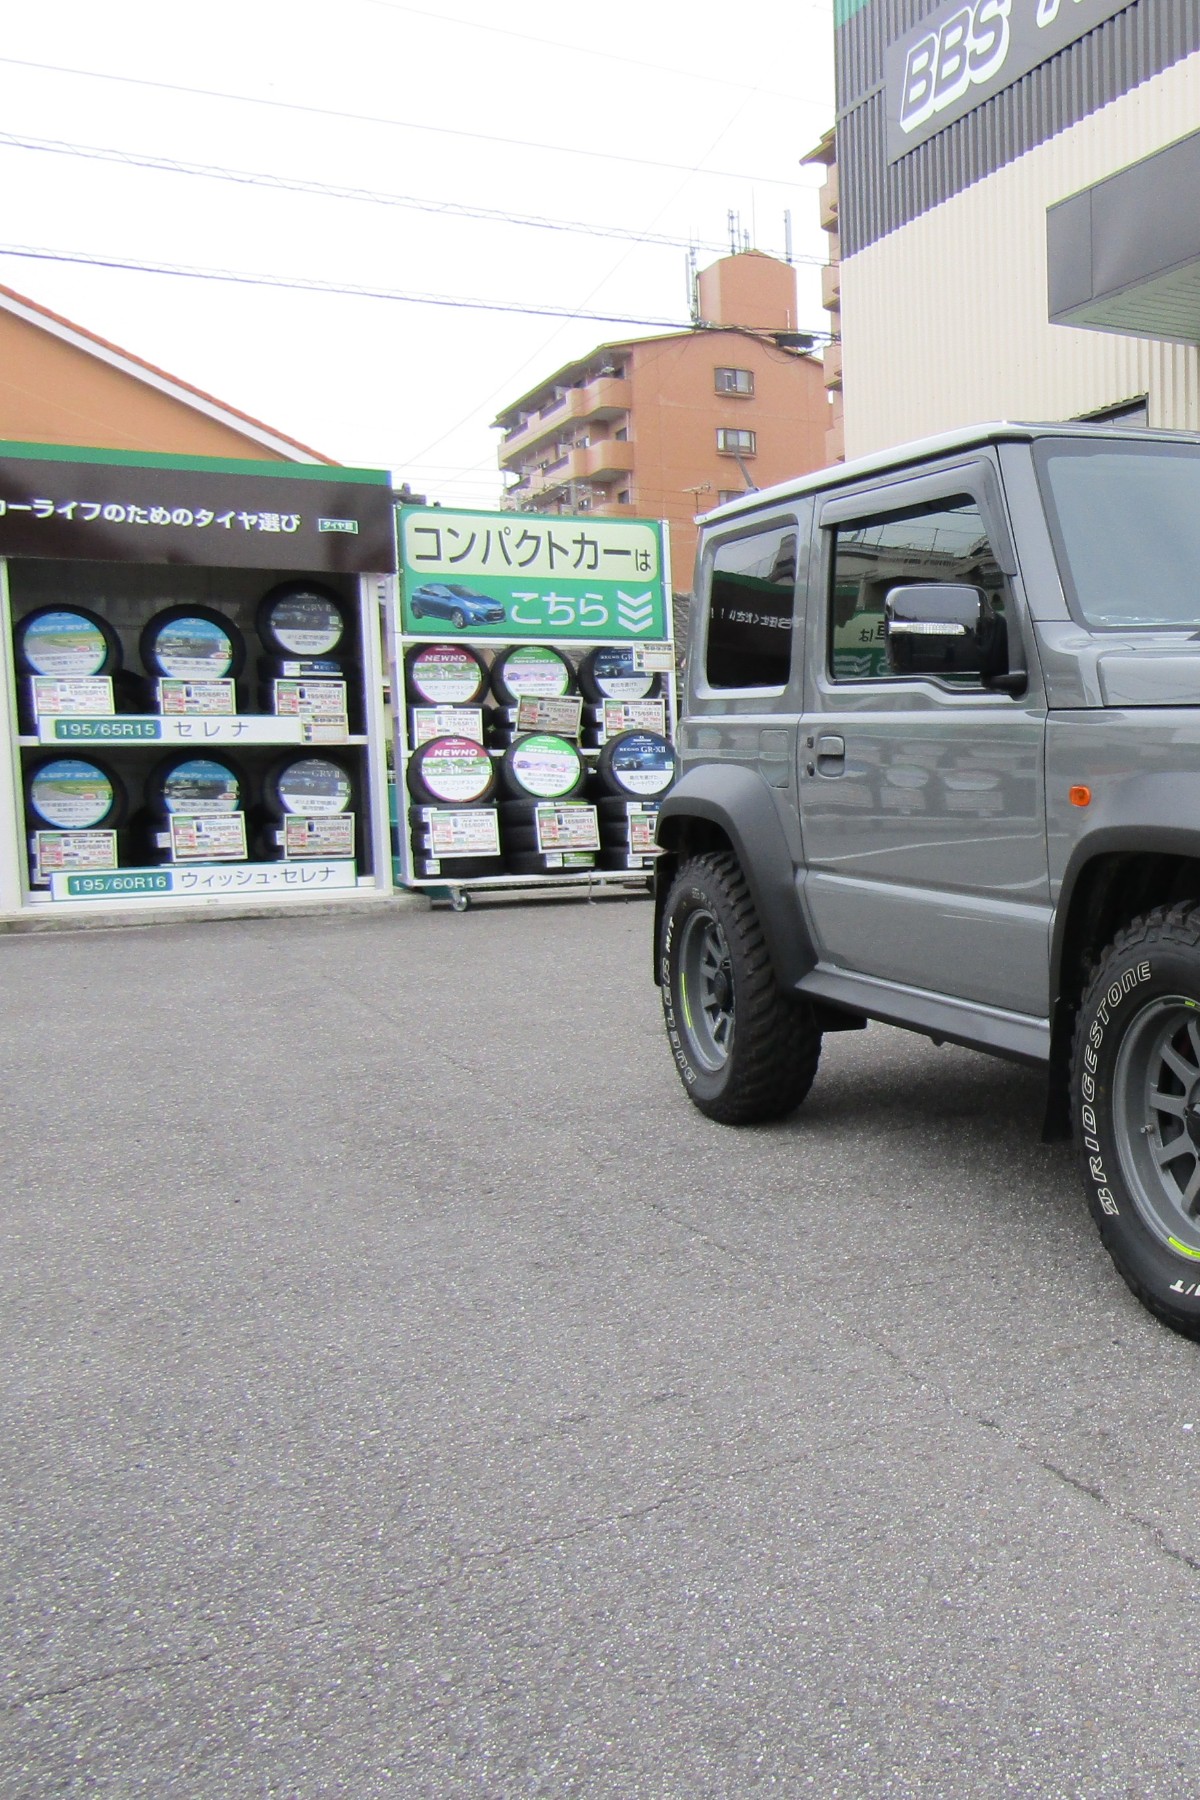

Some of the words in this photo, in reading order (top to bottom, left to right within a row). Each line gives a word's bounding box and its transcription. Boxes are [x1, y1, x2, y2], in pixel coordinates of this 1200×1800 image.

[900, 0, 1012, 133] BBS
[414, 526, 652, 572] コンパクトカーは
[510, 591, 609, 627] こちら
[424, 654, 467, 662] NEWNO
[59, 723, 156, 737] 195/65R15
[433, 748, 478, 757] NEWNO
[73, 875, 167, 892] 195/60R16
[181, 867, 336, 889] ウィッシュ・セレナ
[1080, 961, 1152, 1217] BRIDGESTONE
